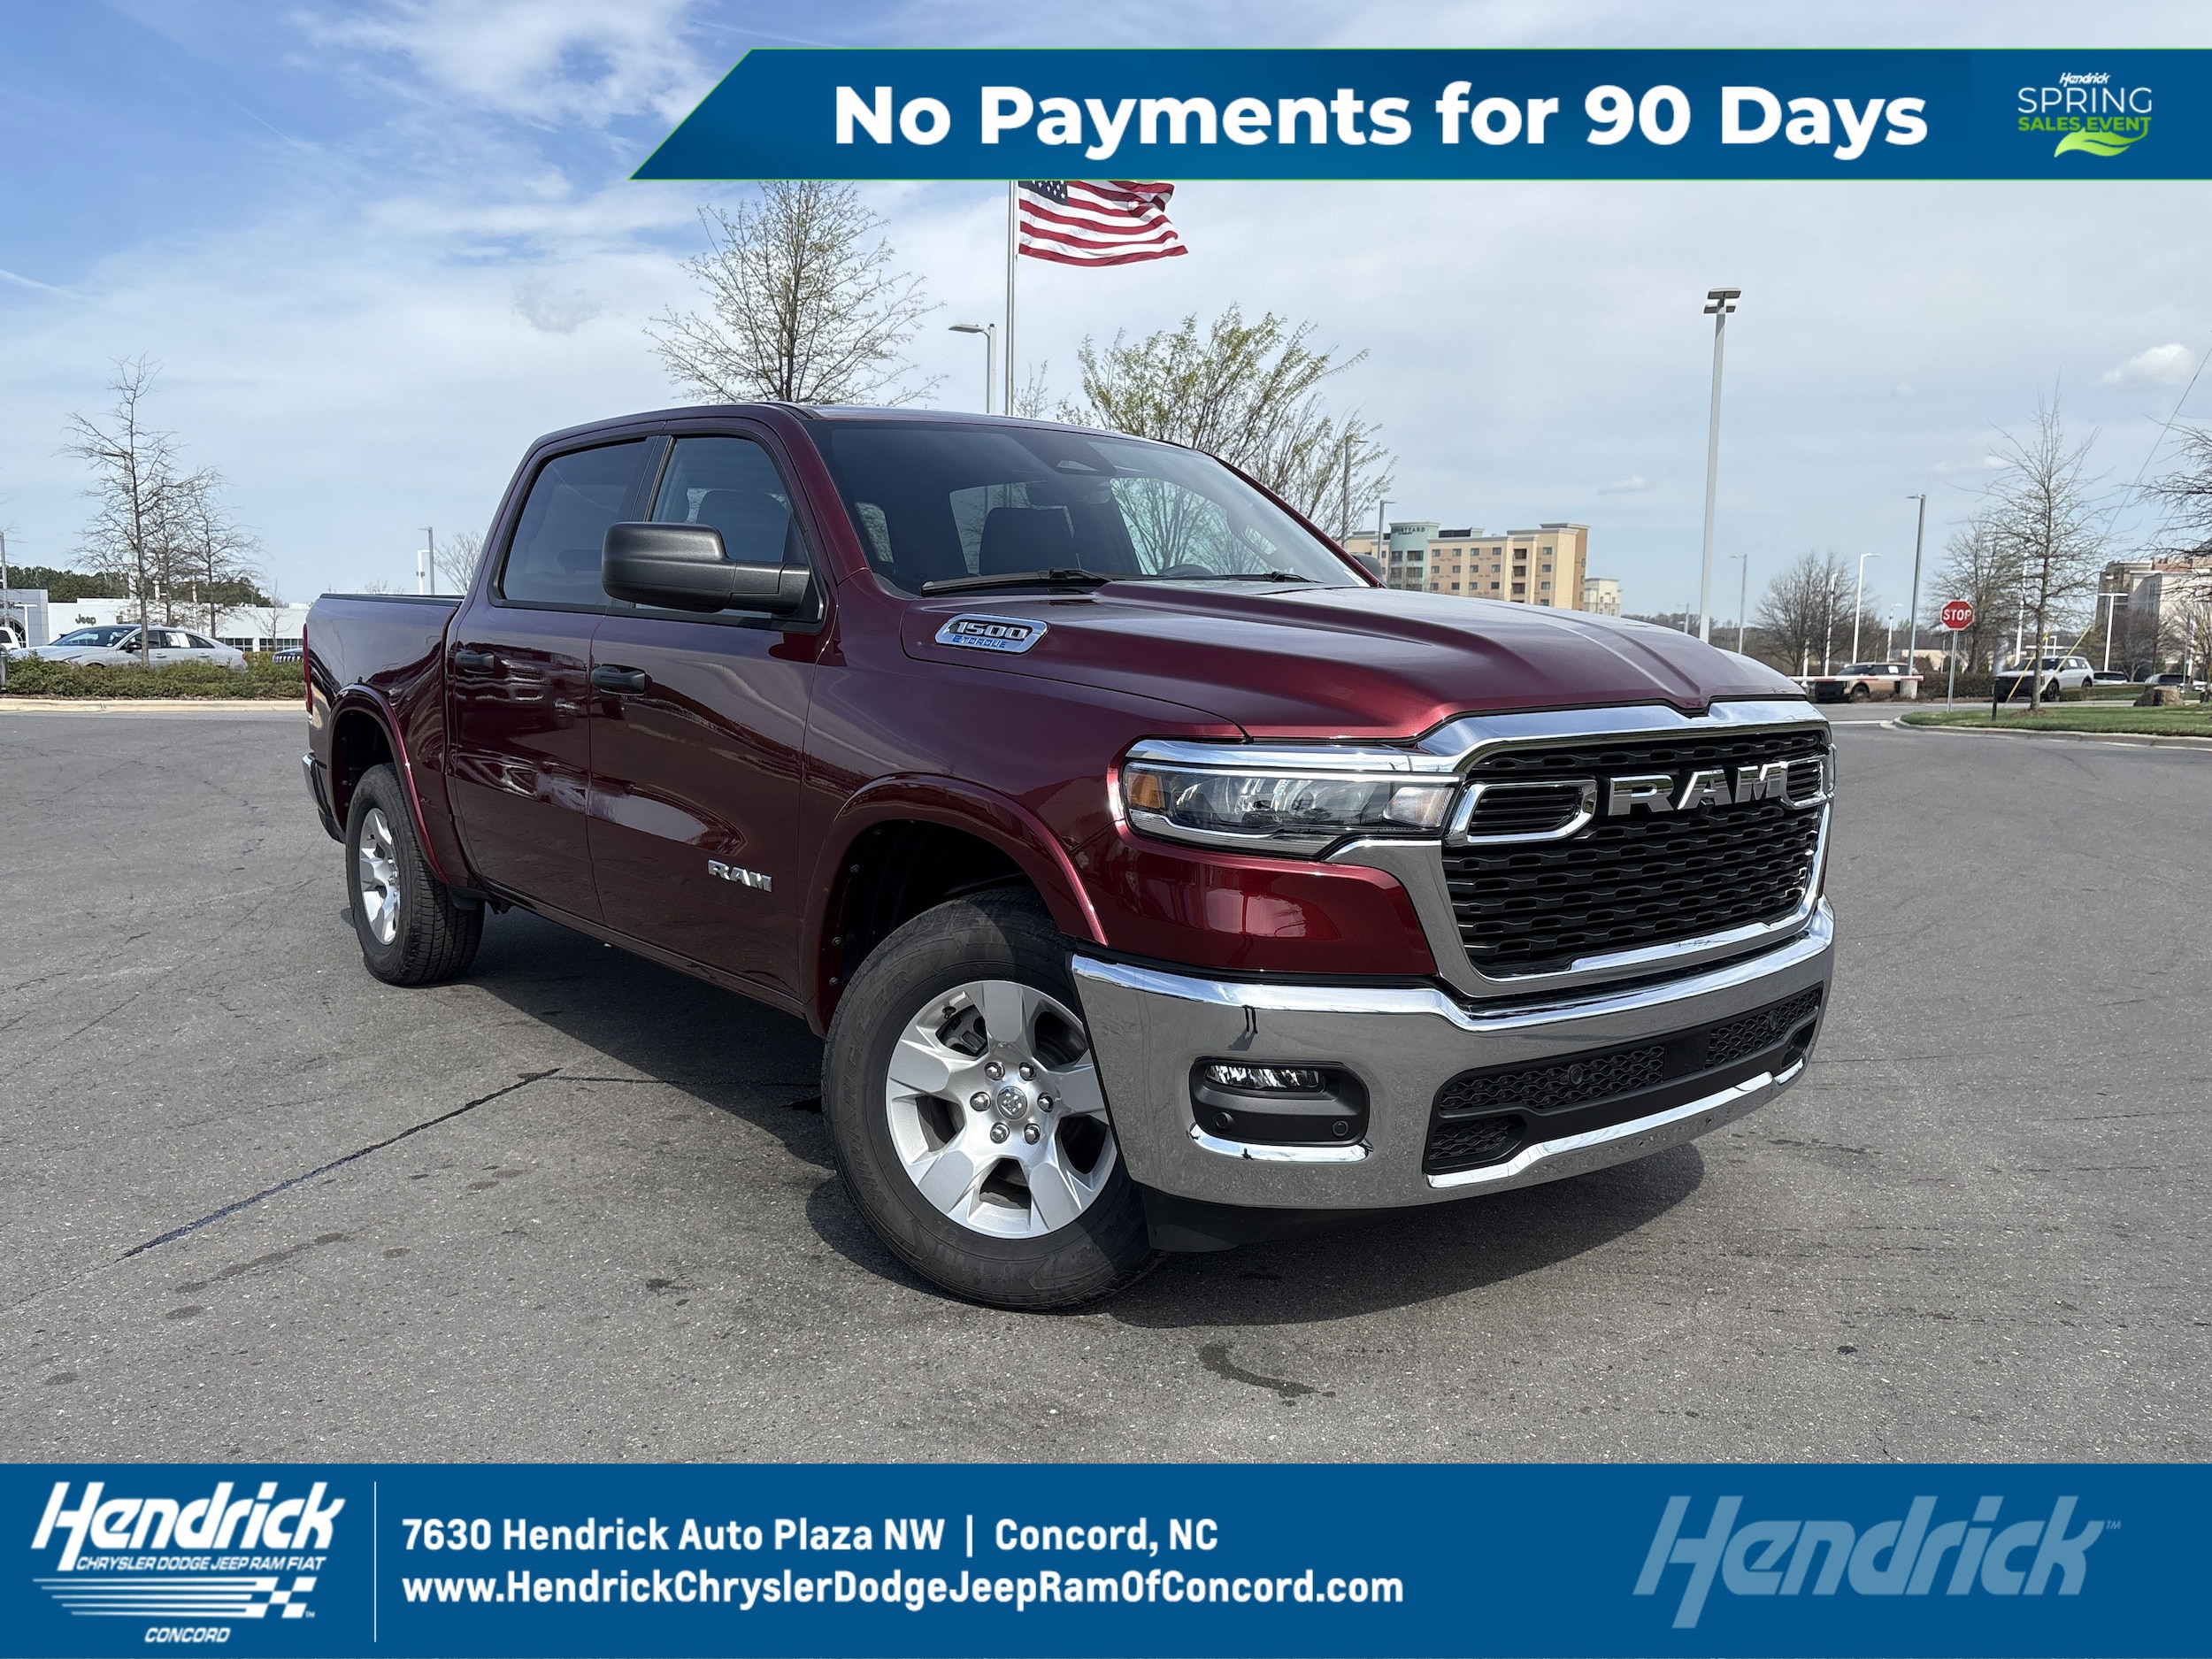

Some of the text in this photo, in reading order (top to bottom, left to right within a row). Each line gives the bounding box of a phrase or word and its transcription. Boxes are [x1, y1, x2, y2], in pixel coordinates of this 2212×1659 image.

[75, 614, 96, 626] Jeep
[1942, 608, 1972, 621] STOP
[956, 621, 1028, 640] 1500
[1607, 759, 1786, 817] RAM
[708, 859, 772, 893] RAM
